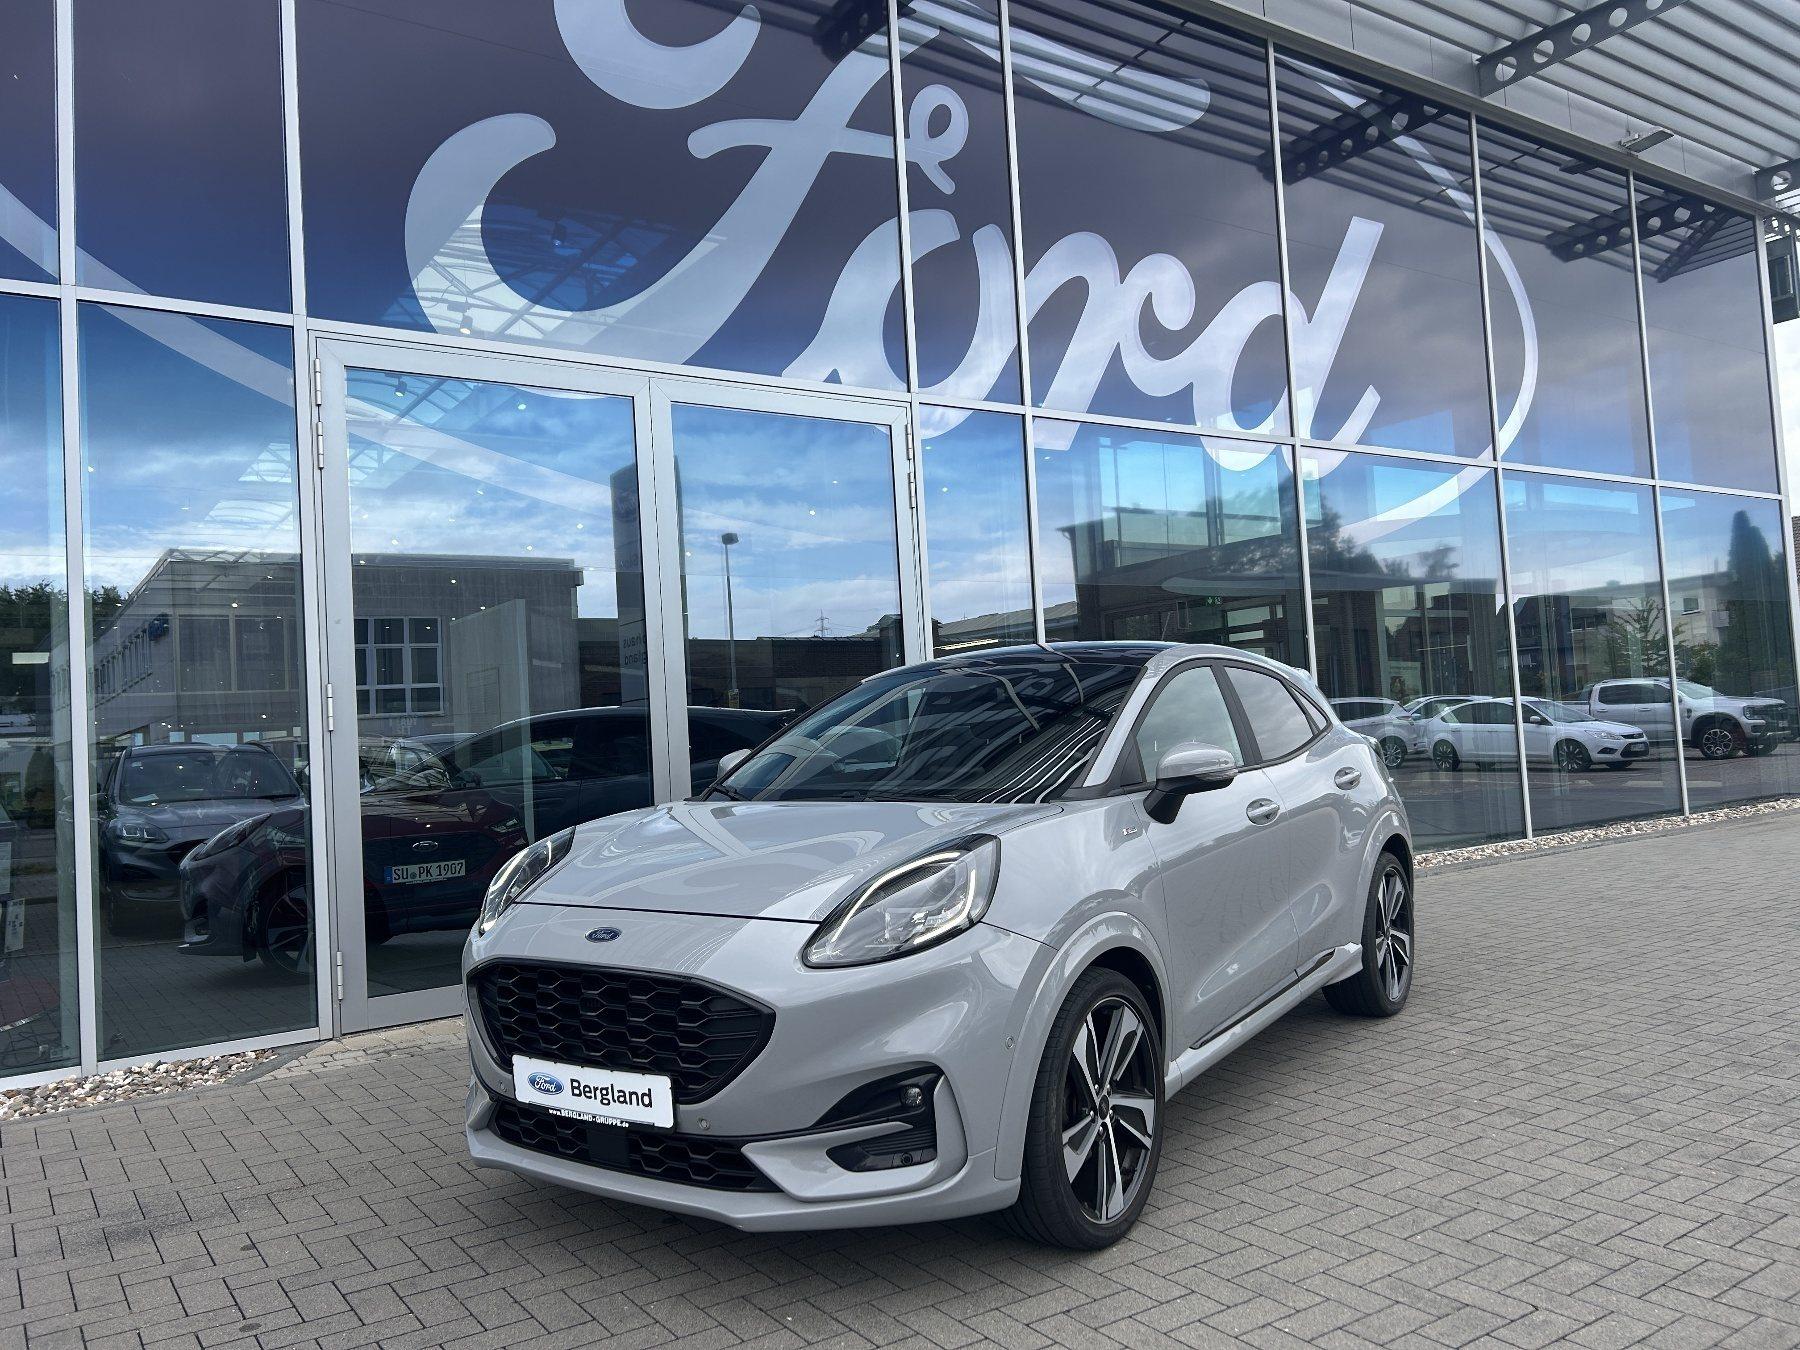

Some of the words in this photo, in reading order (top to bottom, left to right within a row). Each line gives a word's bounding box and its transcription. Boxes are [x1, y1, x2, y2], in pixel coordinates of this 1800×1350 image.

[405, 0, 1384, 478] Ford
[393, 868, 409, 881] SU
[418, 865, 433, 879] PK
[436, 862, 464, 877] 1907
[533, 1074, 559, 1094] Ford
[570, 1078, 653, 1108] Bergland
